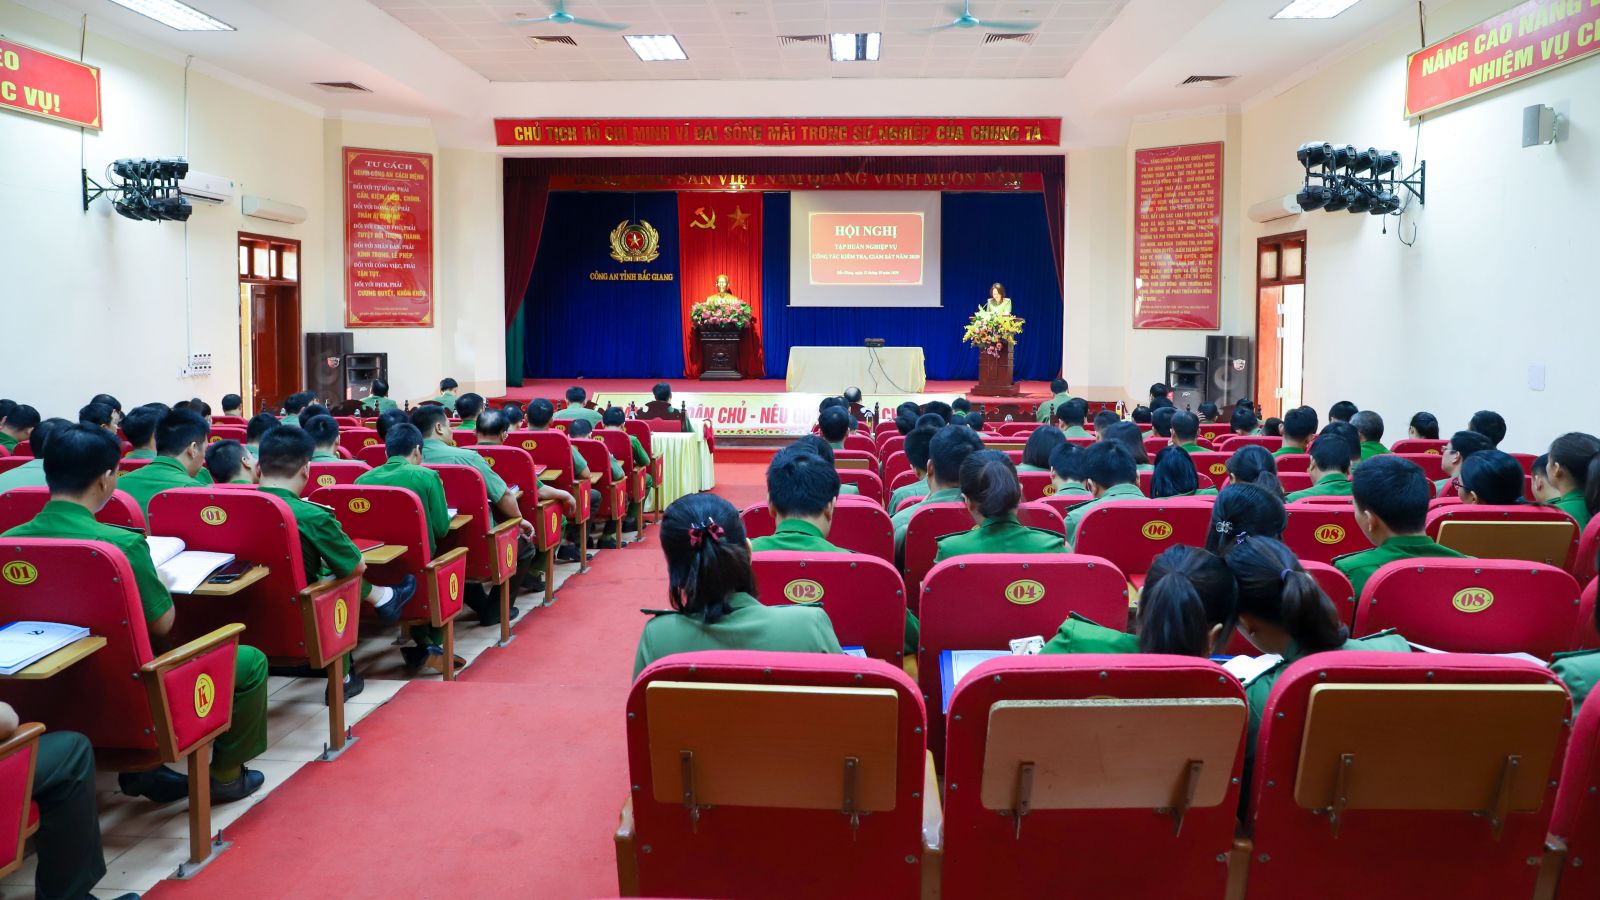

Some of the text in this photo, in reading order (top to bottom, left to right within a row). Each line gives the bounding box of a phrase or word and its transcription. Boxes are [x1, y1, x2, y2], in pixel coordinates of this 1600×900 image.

[1422, 41, 1469, 77] NÂNG
[1474, 22, 1514, 55] CAO
[1468, 46, 1533, 88] NHIỆM
[1540, 30, 1571, 61] VỤ
[23, 85, 60, 114] VỤ!
[514, 122, 541, 141] CHỦ
[546, 126, 577, 143] TỊCH
[583, 122, 600, 141] HỒ
[633, 126, 670, 141] MINH
[694, 126, 719, 144] ĐẠI
[724, 121, 763, 141] SỐNG
[801, 126, 848, 141] TRONG
[1025, 126, 1042, 141] TA
[383, 161, 413, 170] CÁCH
[875, 173, 919, 186] VINH
[834, 224, 897, 239] HỘI NGHỊ
[589, 269, 674, 281] CÔNG AN TỈNH BẮC GIANG
[717, 400, 747, 424] CHỦ
[760, 404, 789, 424] NÊU
[353, 501, 366, 510] 01
[206, 510, 221, 522] 01
[1149, 525, 1167, 536] 06
[1321, 528, 1340, 540] 08
[10, 564, 29, 580] 01
[791, 584, 816, 599] 02
[1013, 584, 1037, 599] 04
[1461, 592, 1486, 607] 08
[197, 684, 209, 708] K
